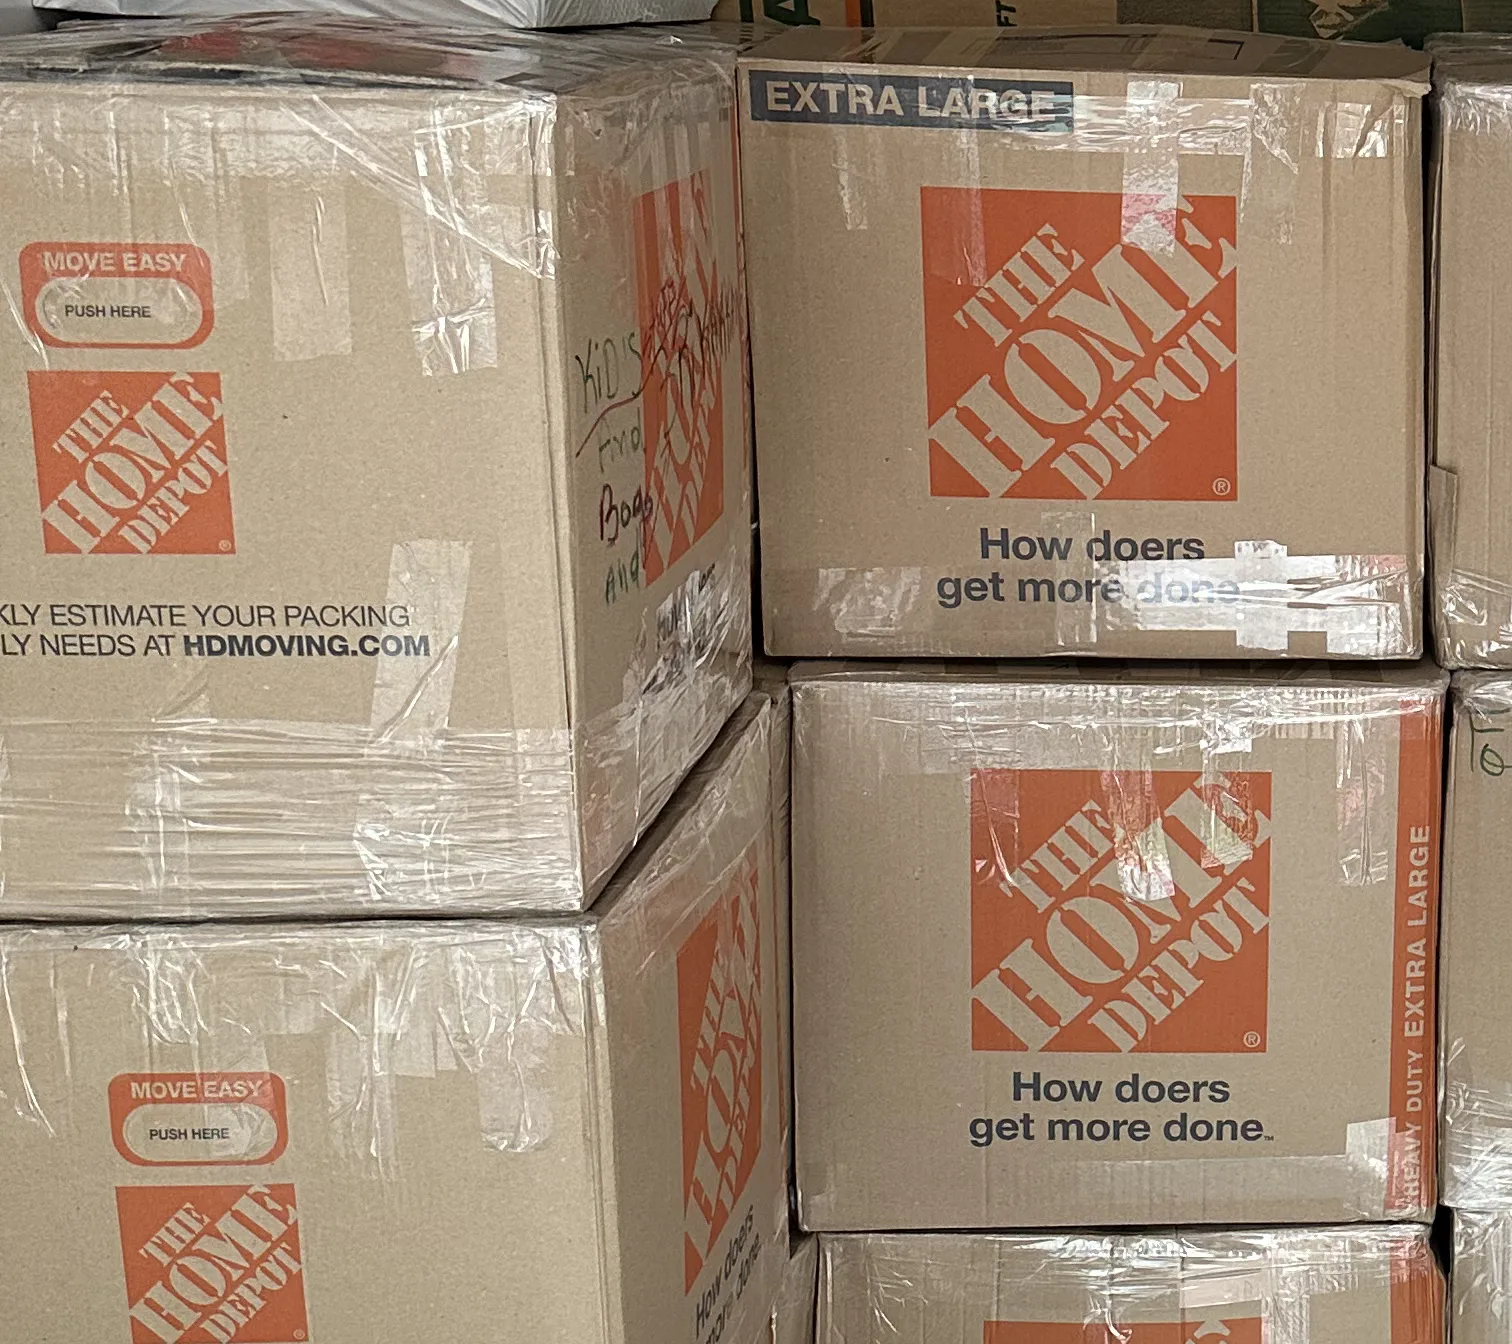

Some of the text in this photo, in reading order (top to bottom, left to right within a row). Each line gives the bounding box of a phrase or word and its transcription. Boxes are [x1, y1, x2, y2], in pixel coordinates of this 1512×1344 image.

[766, 81, 1059, 120] EXTRA LARGE
[45, 252, 186, 272] MOVE EASY
[65, 304, 151, 318] PUSH HERE
[53, 391, 132, 466] THE
[41, 371, 223, 553] HOME
[118, 441, 229, 553] DEPOT
[980, 528, 1205, 562] How doers
[52, 605, 187, 627] ESTIMATE
[193, 606, 276, 627] YOUR
[285, 605, 410, 627] PACKING
[40, 635, 136, 656] NEEDS
[144, 635, 175, 656] AT
[185, 635, 430, 657] HDMOVING.COM
[131, 1079, 263, 1099] MOVE EASY
[1013, 1071, 1230, 1104] How doers
[149, 1126, 229, 1141] PUSH HERE
[969, 1114, 1035, 1147] get
[1048, 1116, 1151, 1141] more
[140, 1203, 213, 1268] THE
[129, 1184, 297, 1344] HOME
[200, 1244, 302, 1342] DEPOT
